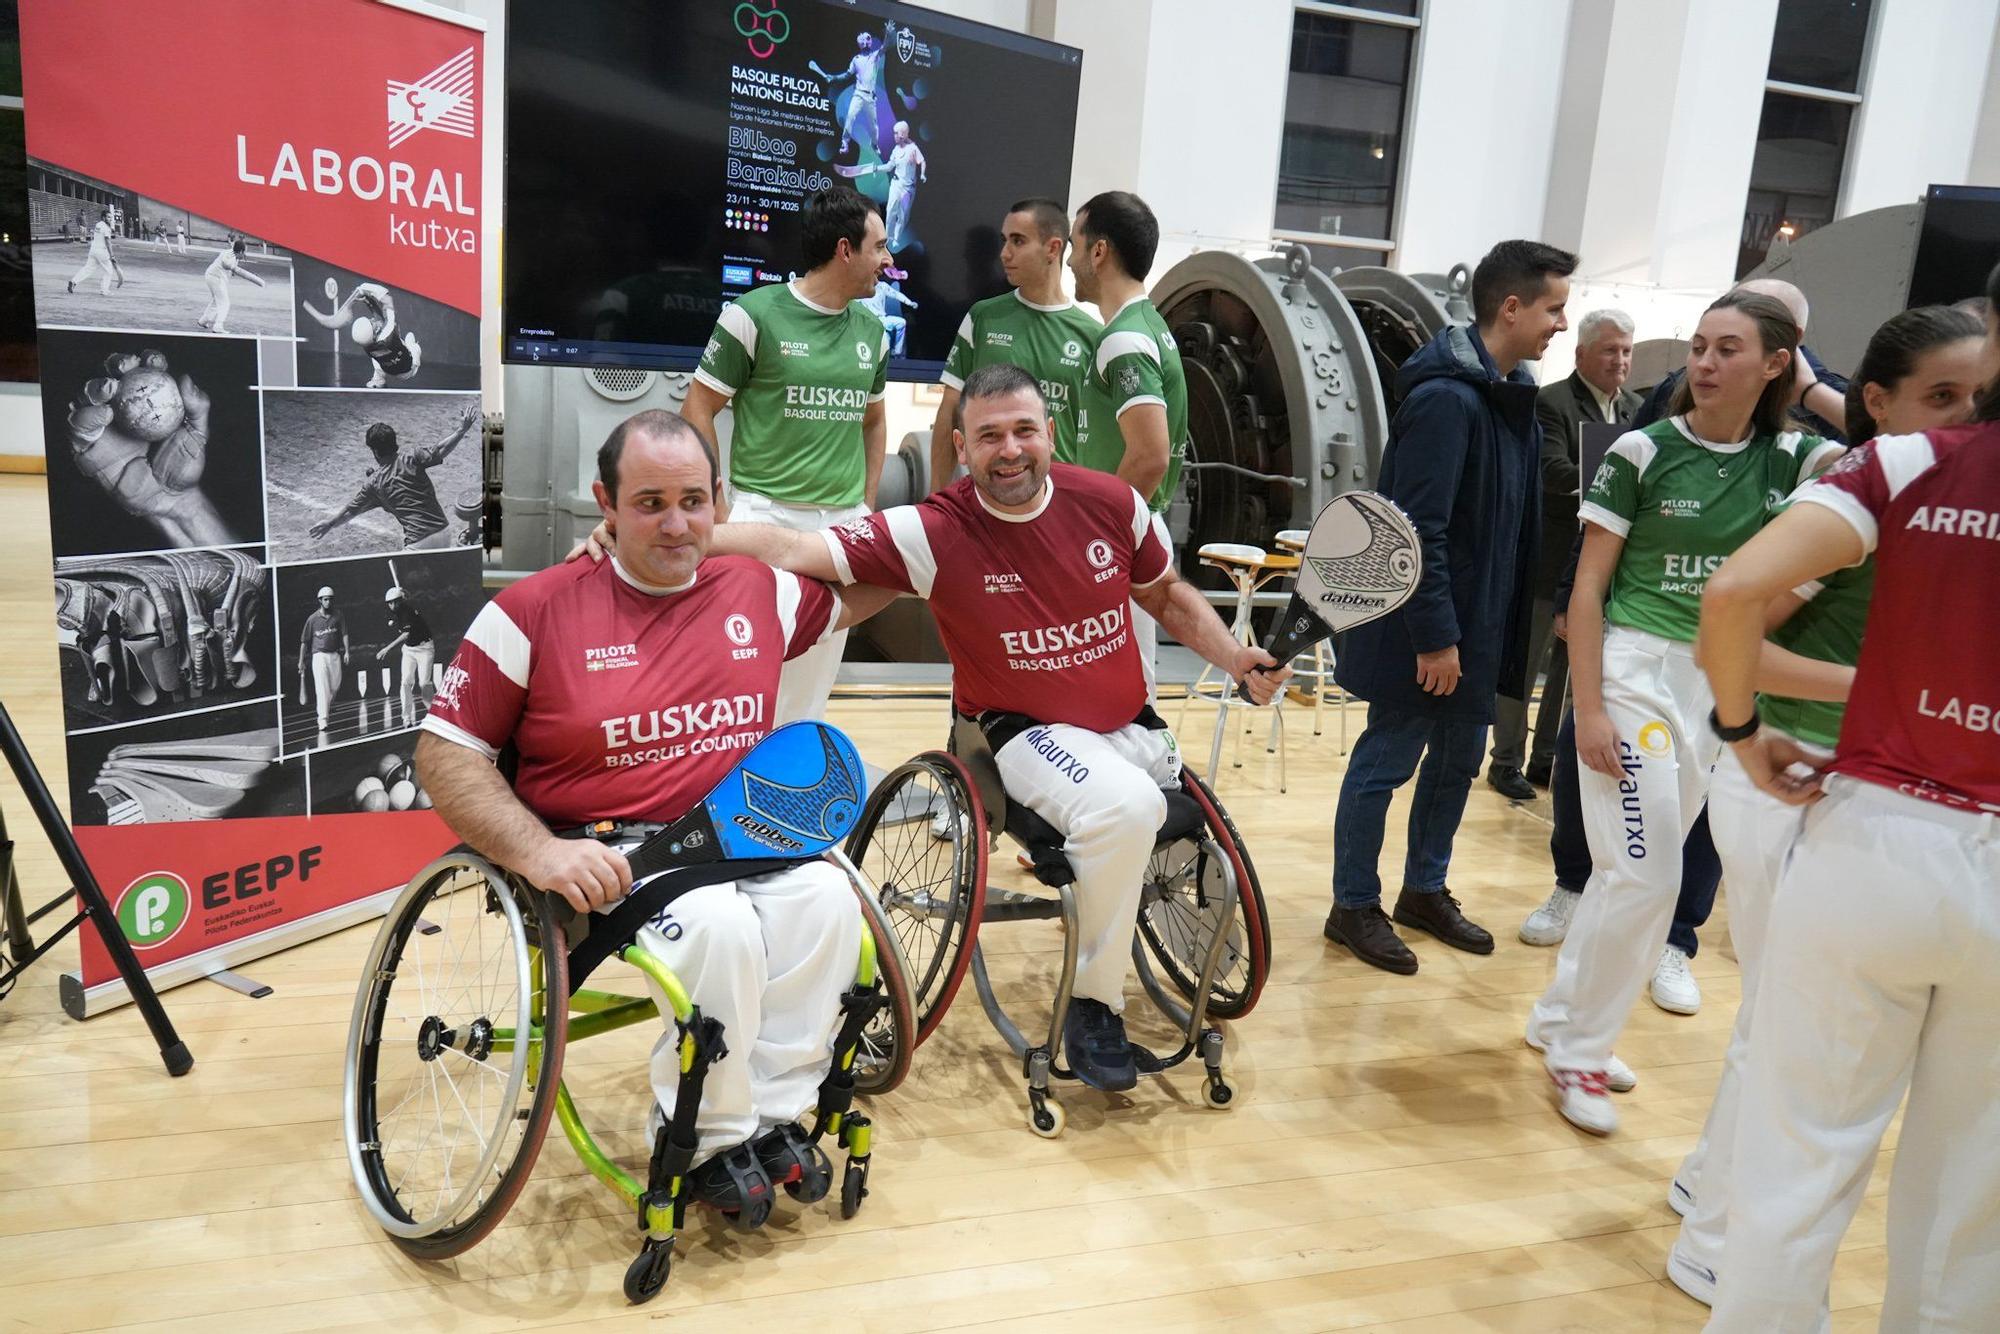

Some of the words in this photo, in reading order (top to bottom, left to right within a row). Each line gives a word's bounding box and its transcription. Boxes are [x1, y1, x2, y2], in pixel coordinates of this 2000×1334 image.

[732, 65, 780, 86] BASQUE
[782, 75, 820, 95] PILOTA
[731, 81, 784, 102] NATIONS
[785, 91, 830, 111] LEAGUE
[728, 126, 797, 157] Bilbao
[237, 134, 475, 216] LABORAL
[727, 157, 833, 192] Barakaldo
[780, 201, 800, 212] 2025
[390, 213, 475, 254] kutxa
[780, 341, 809, 350] PILOTA
[784, 408, 827, 420] BASQUE
[1661, 499, 1701, 509] PILOTA
[1905, 506, 2000, 541] ARRI
[984, 573, 1022, 584] PILOTA
[1094, 566, 1119, 584] EEPF
[1321, 592, 1386, 608] dabber
[1000, 604, 1125, 655] EUSKADI
[585, 643, 636, 660] PILOTA
[732, 647, 759, 660] EEPF
[1008, 655, 1072, 672] BASQUE
[1073, 631, 1127, 665] COUNTRY
[600, 693, 763, 749] EUSKADI
[605, 742, 685, 769] BASQUE
[690, 730, 763, 756] COUNTRY
[733, 814, 804, 849] dabber
[202, 845, 323, 910] EEPF
[204, 908, 247, 926] Euskadiko
[204, 924, 228, 936] Pilota
